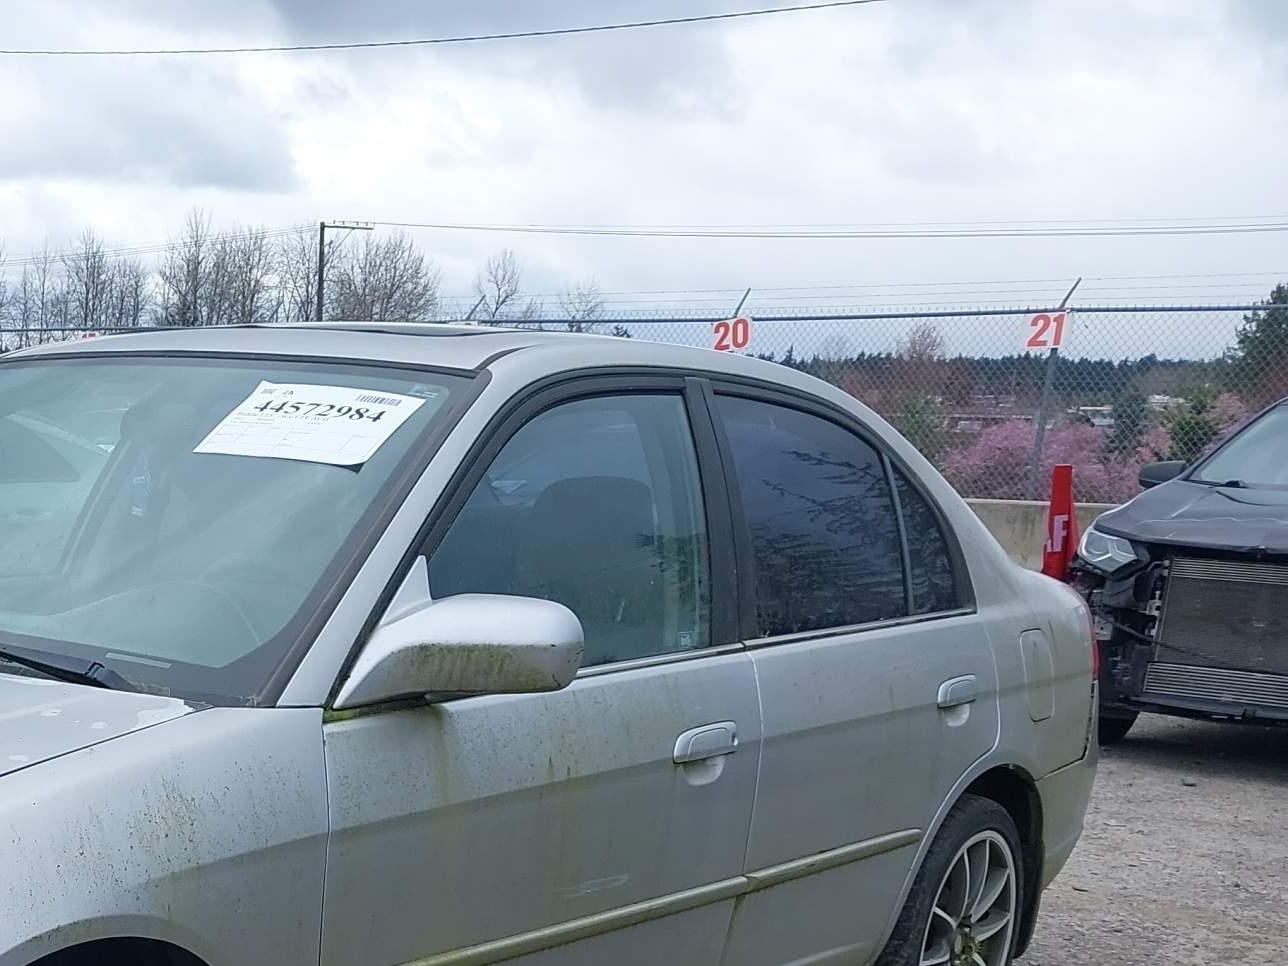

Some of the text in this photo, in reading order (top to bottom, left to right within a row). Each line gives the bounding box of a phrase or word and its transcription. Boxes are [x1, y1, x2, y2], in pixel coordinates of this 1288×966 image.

[714, 319, 748, 350] 20
[1027, 313, 1065, 347] 21
[253, 399, 387, 423] 44572984
